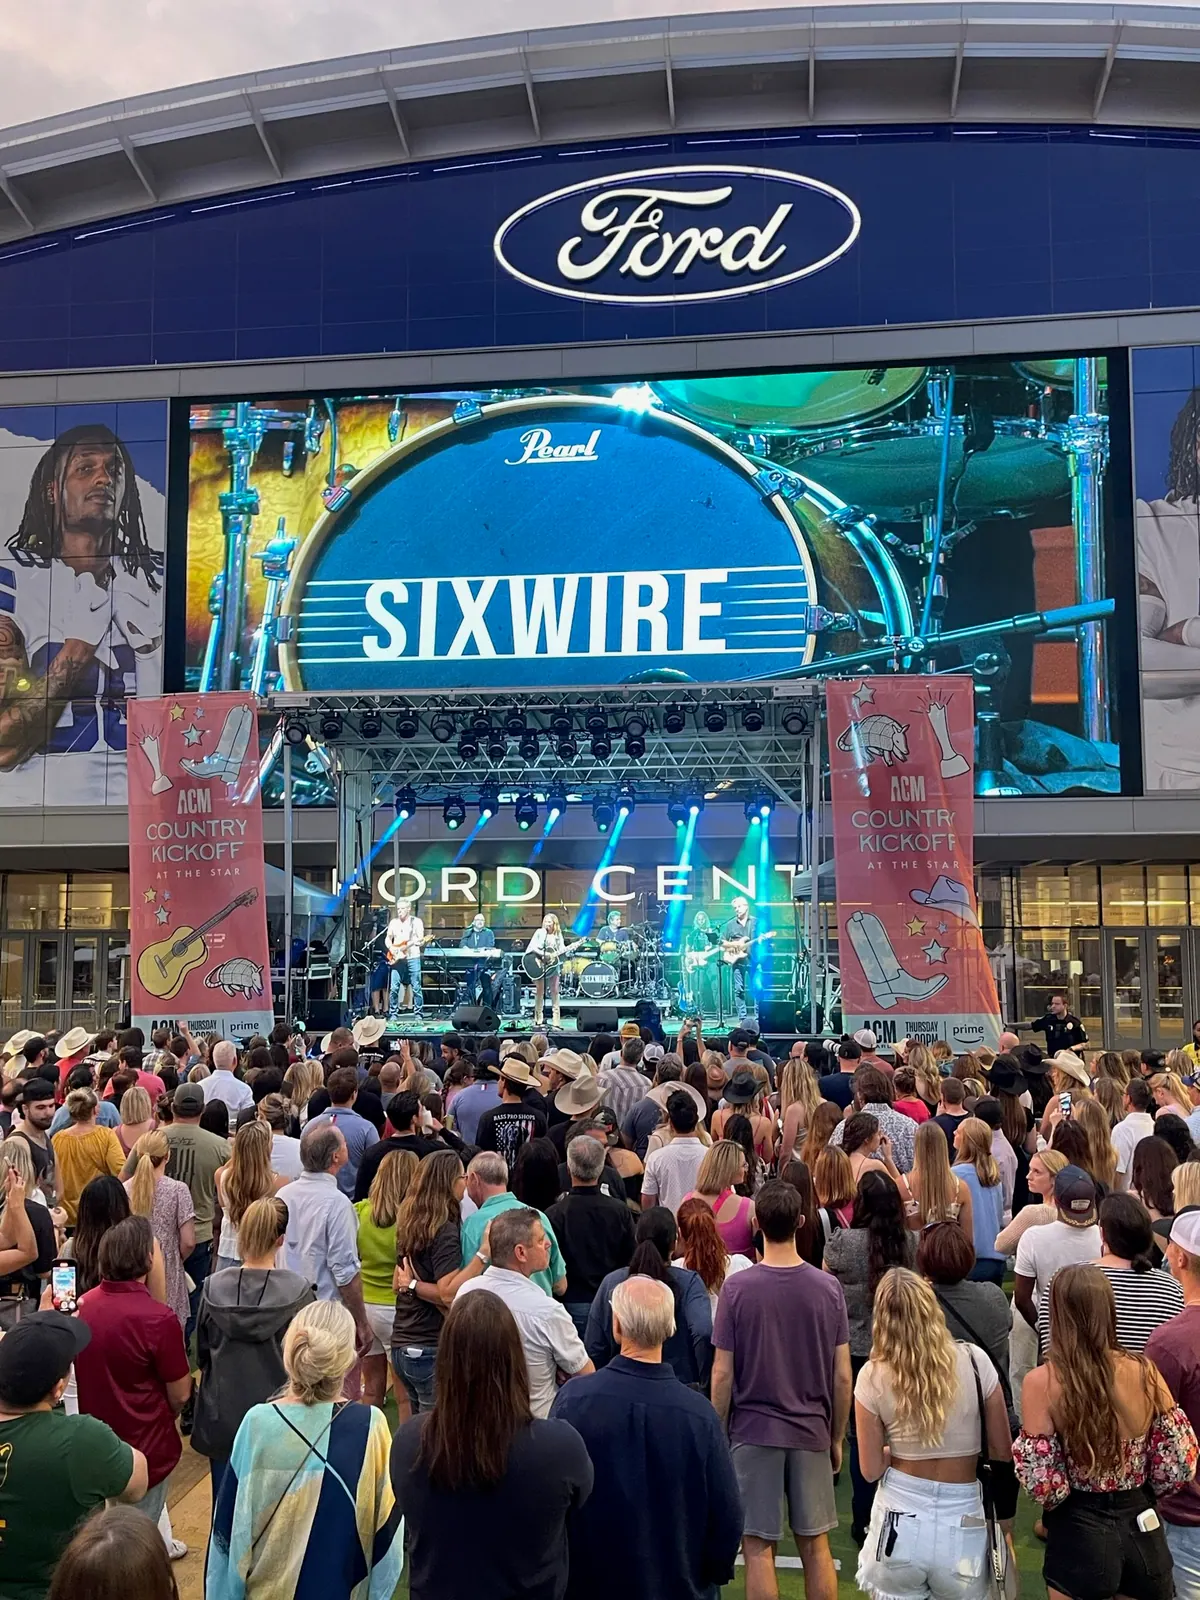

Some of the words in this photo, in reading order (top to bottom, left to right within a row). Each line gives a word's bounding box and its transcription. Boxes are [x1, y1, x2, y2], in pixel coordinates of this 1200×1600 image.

[557, 185, 794, 280] Ford
[504, 429, 601, 465] Pearl
[362, 570, 728, 660] SIXWIRE
[891, 775, 926, 802] ACM
[177, 788, 212, 815] ACM
[146, 818, 248, 841] COUNTRY
[151, 841, 244, 863] KICKOFF
[860, 834, 956, 853] KICKOFF
[156, 871, 169, 880] AT
[176, 869, 201, 879] THE
[210, 867, 241, 877] STAR
[867, 861, 883, 870] AT
[892, 861, 918, 870] THE
[926, 860, 960, 870] STAR
[187, 1020, 217, 1031] THURSDAY
[230, 1021, 260, 1033] prime
[905, 1021, 939, 1032] THURSDAY
[953, 1024, 984, 1036] prime
[905, 1033, 939, 1047] 00PM
